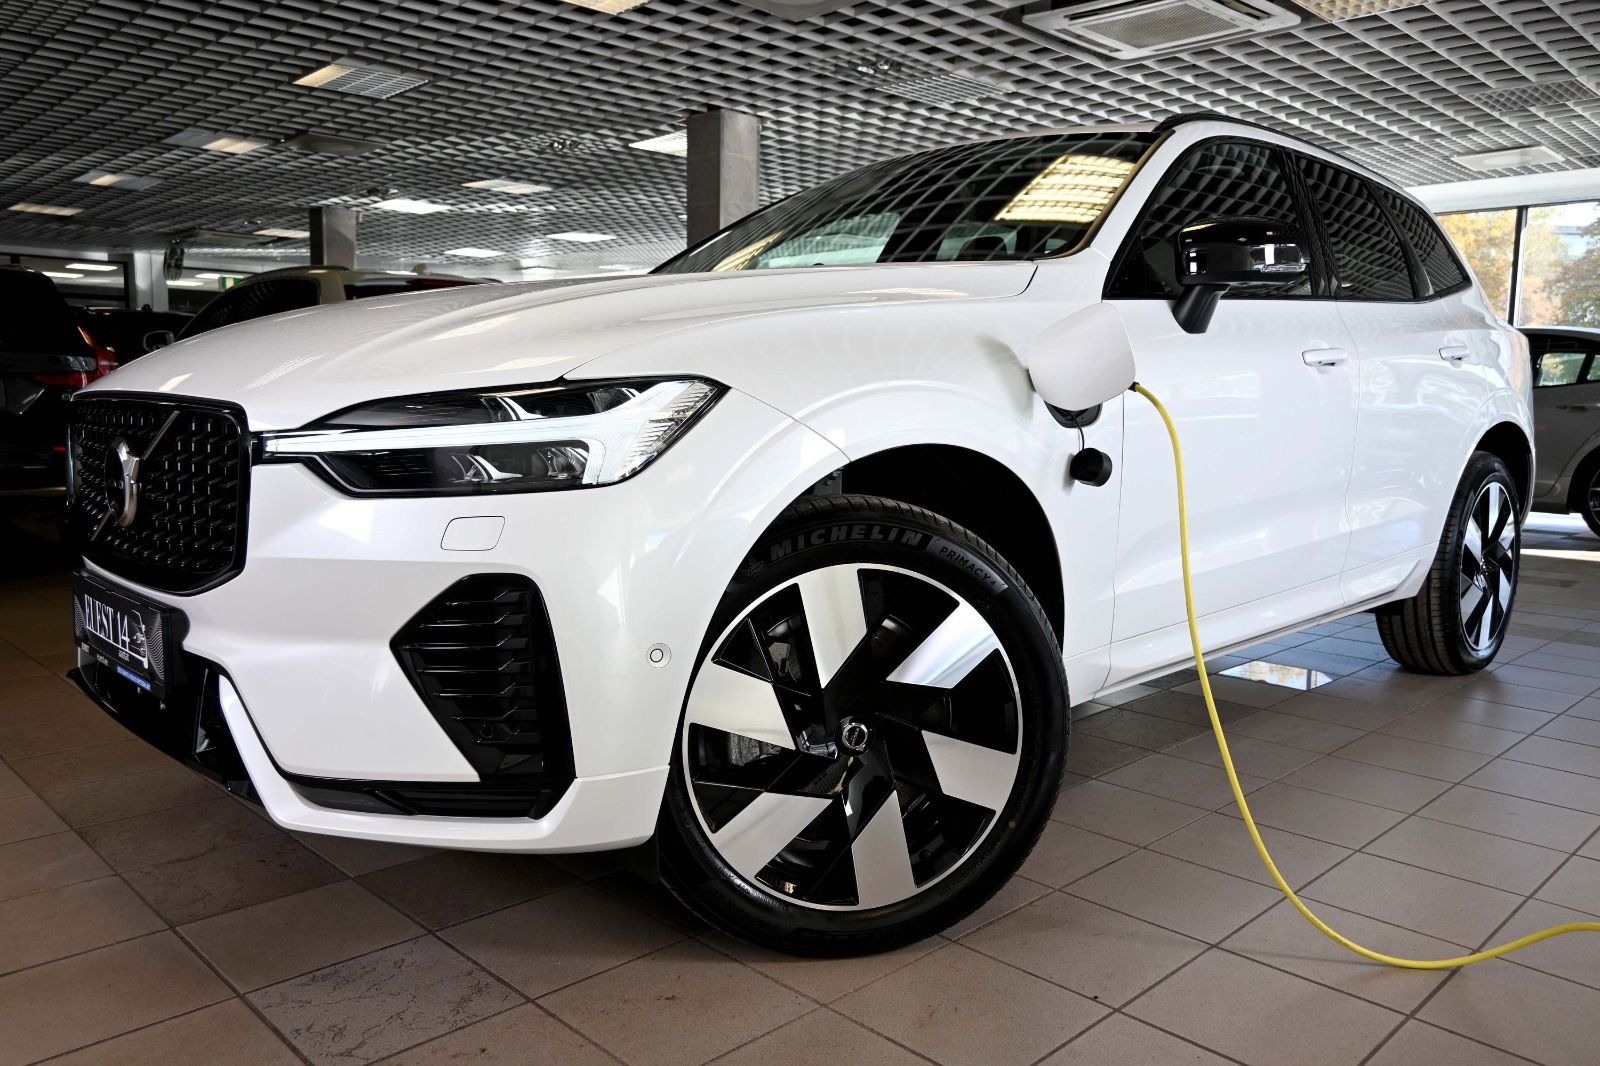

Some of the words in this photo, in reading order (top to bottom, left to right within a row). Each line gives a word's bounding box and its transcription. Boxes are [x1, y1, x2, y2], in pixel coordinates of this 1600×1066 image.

[770, 525, 923, 561] MICHELIN
[938, 546, 991, 581] PRIMACY
[117, 611, 130, 652] 14
